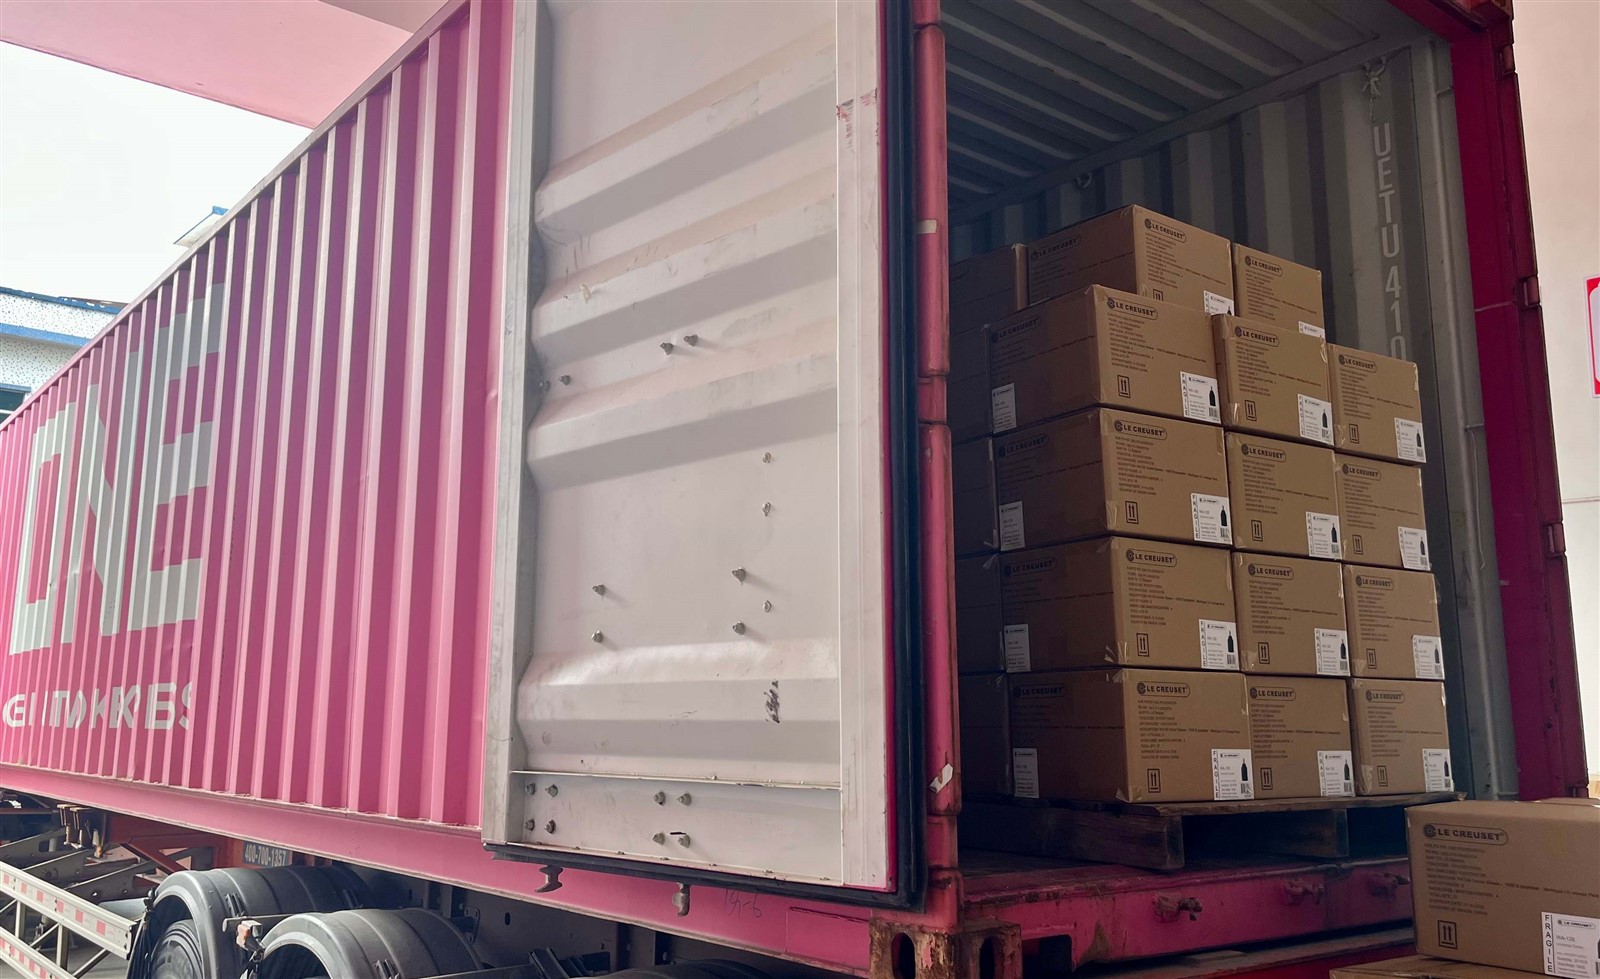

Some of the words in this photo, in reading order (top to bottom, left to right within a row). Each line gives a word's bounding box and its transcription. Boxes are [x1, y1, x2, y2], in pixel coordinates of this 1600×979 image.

[1374, 124, 1400, 257] UETU
[1159, 225, 1184, 240] CREUSET
[1258, 261, 1280, 273] CREUSET
[1115, 302, 1125, 310] LE
[1125, 303, 1155, 317] CREUSET
[1250, 332, 1277, 344] CREUSET
[1132, 426, 1164, 437] CREUSET
[1258, 449, 1284, 459] CREUSET
[10, 282, 225, 655] ONE
[1144, 554, 1174, 564] CREUSET
[1264, 568, 1291, 577] CREUSET
[1156, 686, 1187, 694] CREUSET
[1212, 750, 1220, 798] FRAGILE
[1438, 828, 1450, 836] LE
[1452, 830, 1500, 840] CREUSET
[244, 844, 286, 867] 400-700-1357
[1544, 914, 1553, 973] FRAGILE
